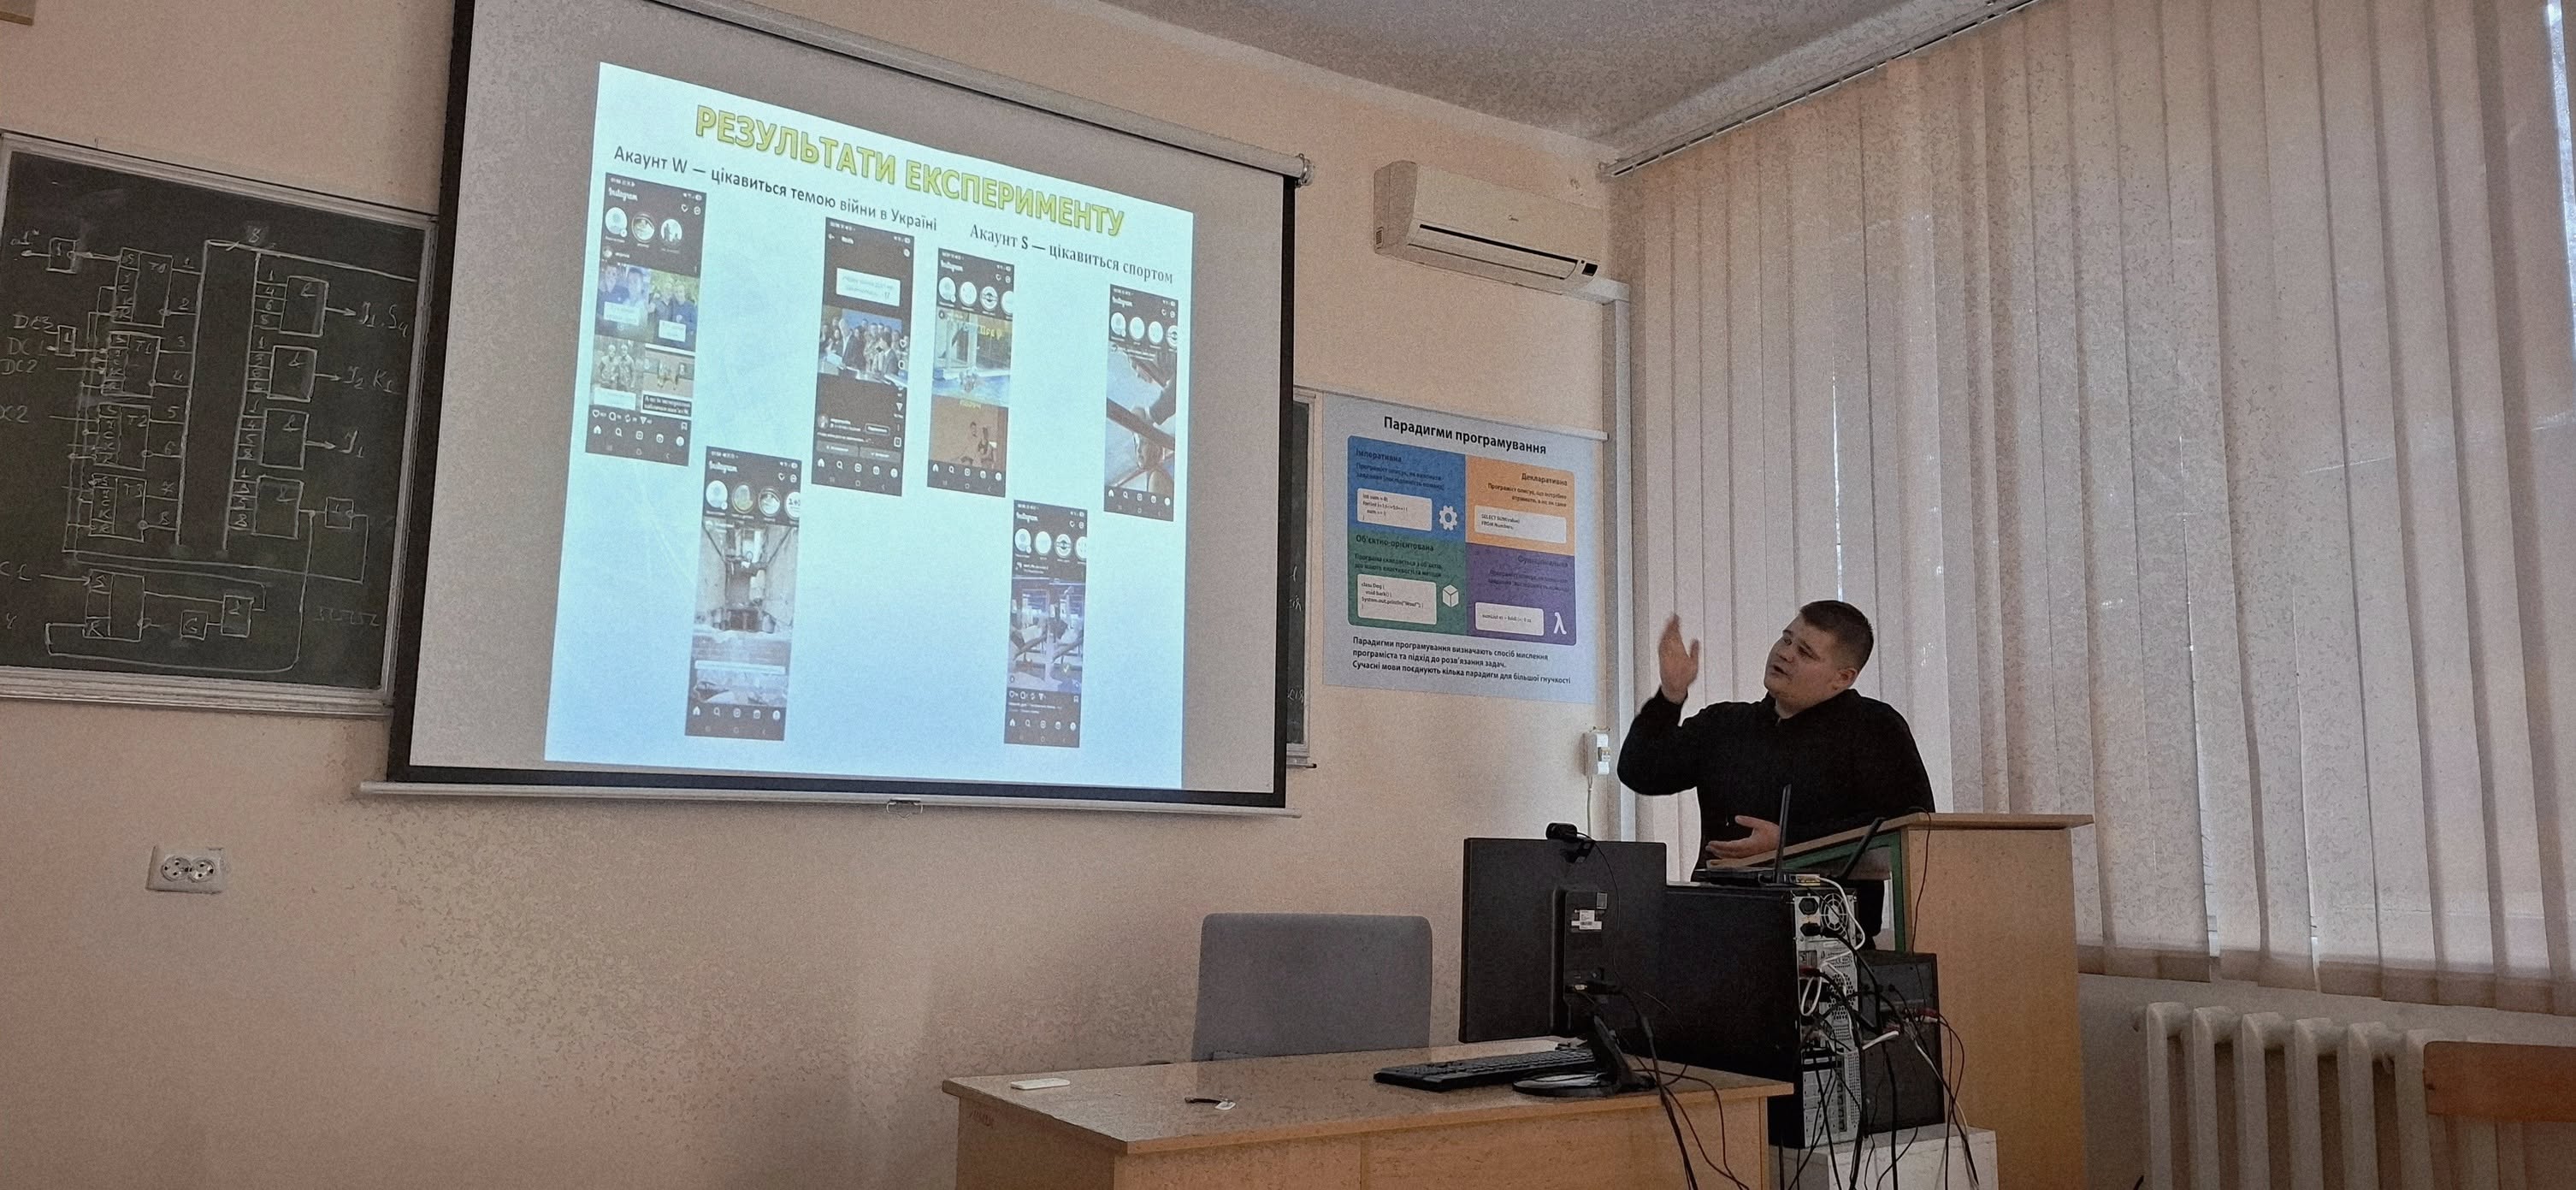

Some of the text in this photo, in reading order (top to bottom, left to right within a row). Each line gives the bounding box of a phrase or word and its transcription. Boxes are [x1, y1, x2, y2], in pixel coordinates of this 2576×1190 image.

[695, 104, 1125, 237] РЕЗУЛЬТАТИ ЕКСПЕРИМЕНТУ
[614, 145, 667, 170] Акаунт
[672, 157, 688, 174] W
[711, 168, 786, 197] цікавиться
[791, 188, 836, 208] темою
[840, 198, 876, 217] війни
[880, 209, 888, 220] в
[891, 209, 936, 231] Україні
[970, 224, 1018, 248] Акаунт
[1021, 236, 1029, 250] S
[1049, 243, 1120, 271] цікавиться
[1123, 263, 1173, 284] спортом
[1384, 416, 1546, 454] Парадигми програмування
[1521, 472, 1568, 486] Декларативна
[1553, 612, 1568, 635] λ
[1353, 636, 1394, 648] Парадигми
[1395, 642, 1450, 653] програмування
[1452, 646, 1492, 656] визначають
[1494, 649, 1515, 658] спосіб
[1353, 649, 1397, 660] програміста
[1408, 653, 1430, 663] підхід
[1441, 656, 1484, 667] розв'язання
[1352, 660, 1380, 670] Сучасні
[1402, 665, 1441, 675] поєднують
[1442, 666, 1464, 676] кілька
[1465, 670, 1498, 678] парадигм
[1513, 672, 1539, 682] більшої
